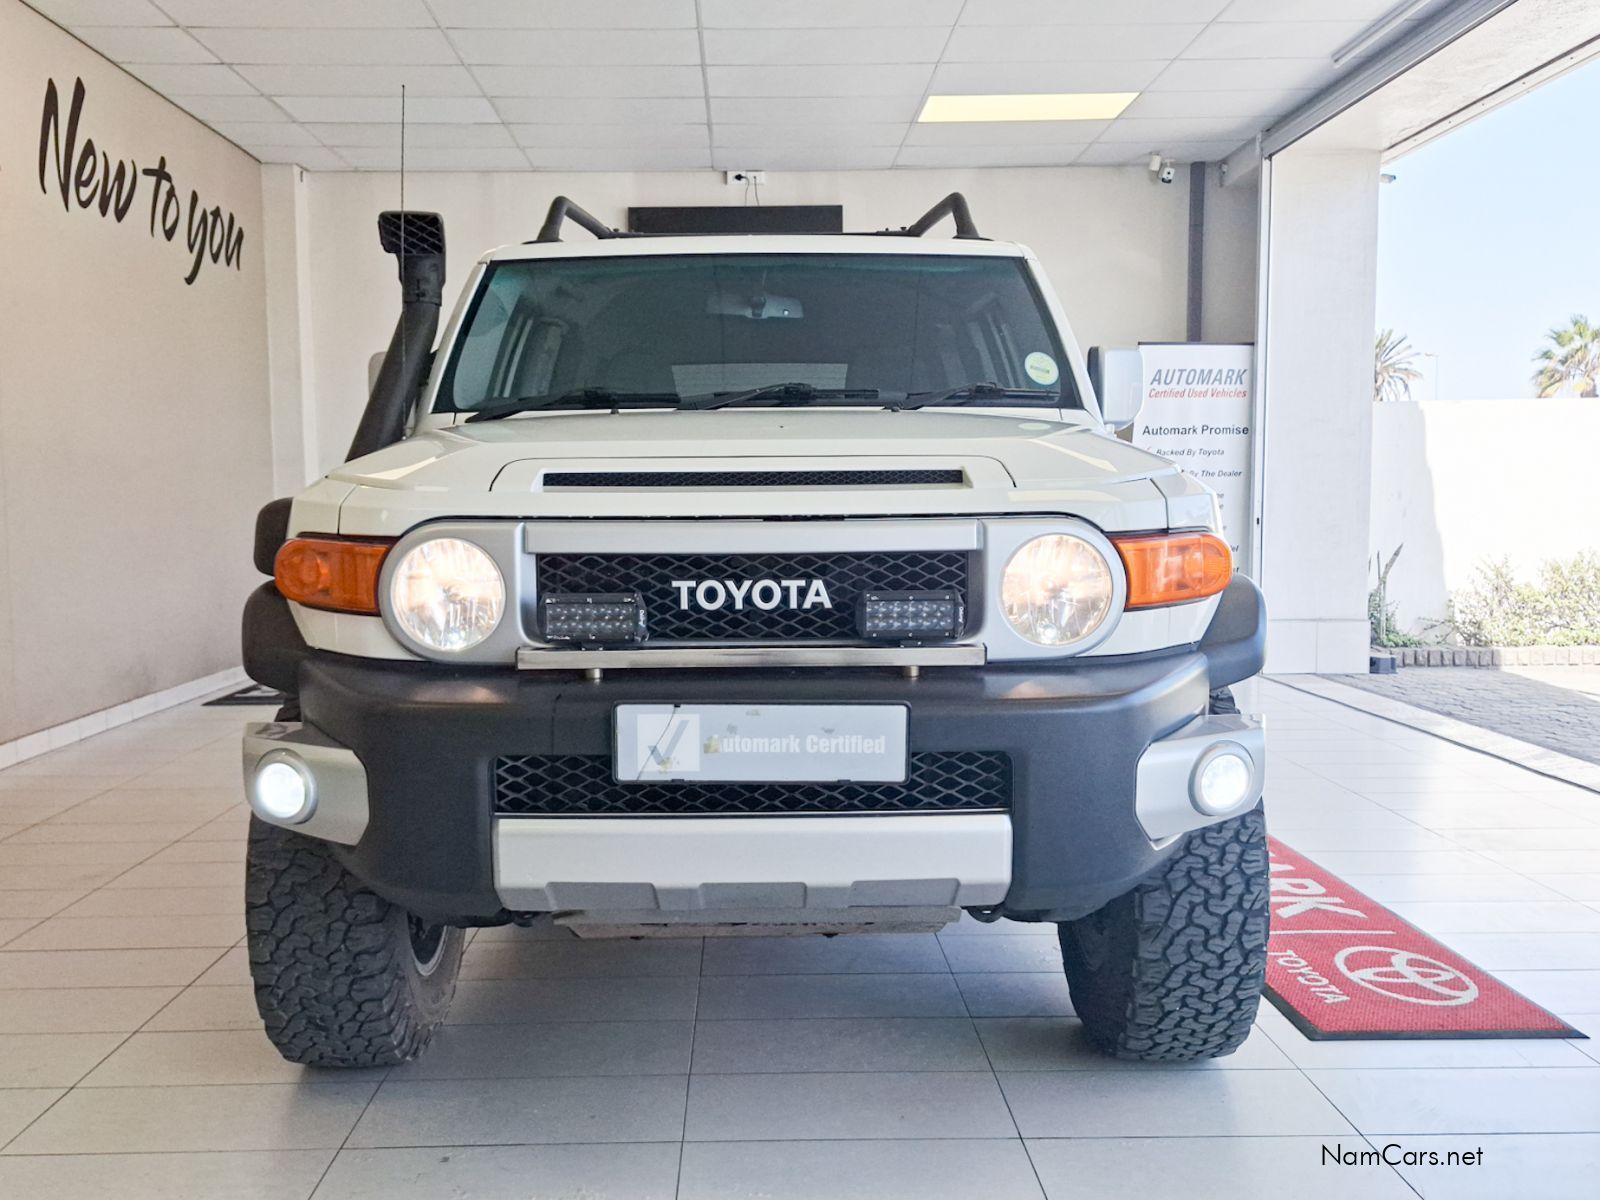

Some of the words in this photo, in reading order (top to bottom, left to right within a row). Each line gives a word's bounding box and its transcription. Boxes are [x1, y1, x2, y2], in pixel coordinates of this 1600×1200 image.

[39, 76, 137, 223] New
[142, 156, 180, 242] to
[184, 189, 244, 285] you
[1150, 368, 1248, 386] AUTOMARK
[1148, 388, 1186, 399] Certified
[1187, 388, 1209, 398] Used
[1211, 387, 1248, 398] Vehicles
[1142, 425, 1198, 436] Automark
[1201, 424, 1249, 435] Promise
[1186, 448, 1197, 458] By
[1199, 447, 1225, 457] Toyota
[1201, 469, 1216, 478] The
[1217, 469, 1242, 478] Dealer
[671, 579, 833, 611] TOYOTA
[806, 734, 886, 754] Certified
[1267, 949, 1351, 1004] TOYOTA
